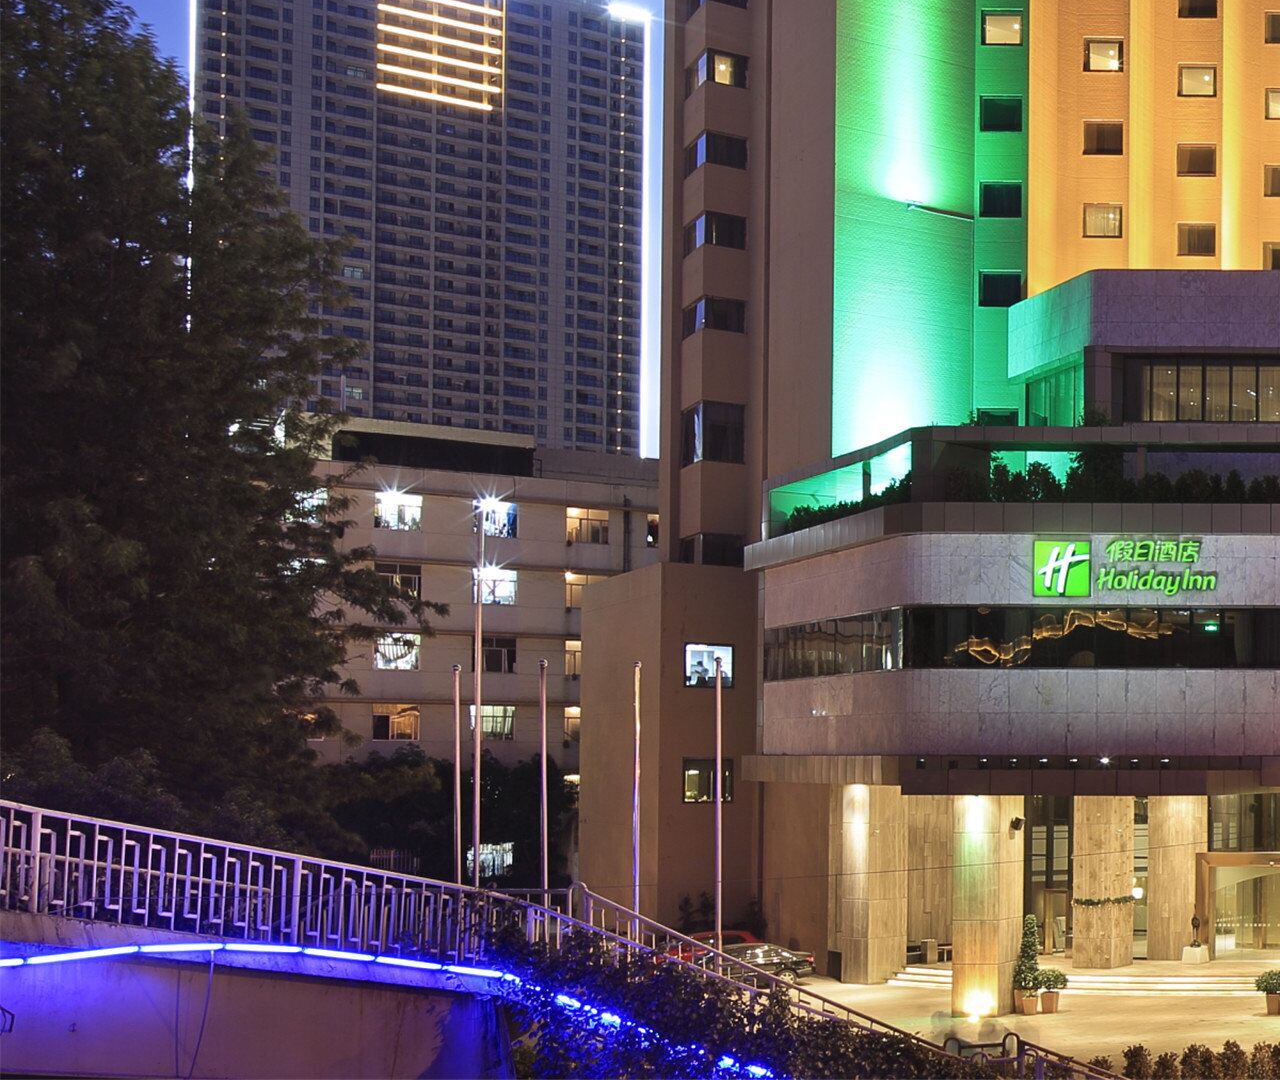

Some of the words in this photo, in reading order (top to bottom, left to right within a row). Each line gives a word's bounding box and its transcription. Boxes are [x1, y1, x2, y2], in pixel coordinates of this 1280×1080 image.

[1105, 539, 1201, 563] 假日酒店
[1096, 566, 1181, 596] Holiday
[1182, 567, 1217, 591] Inn
